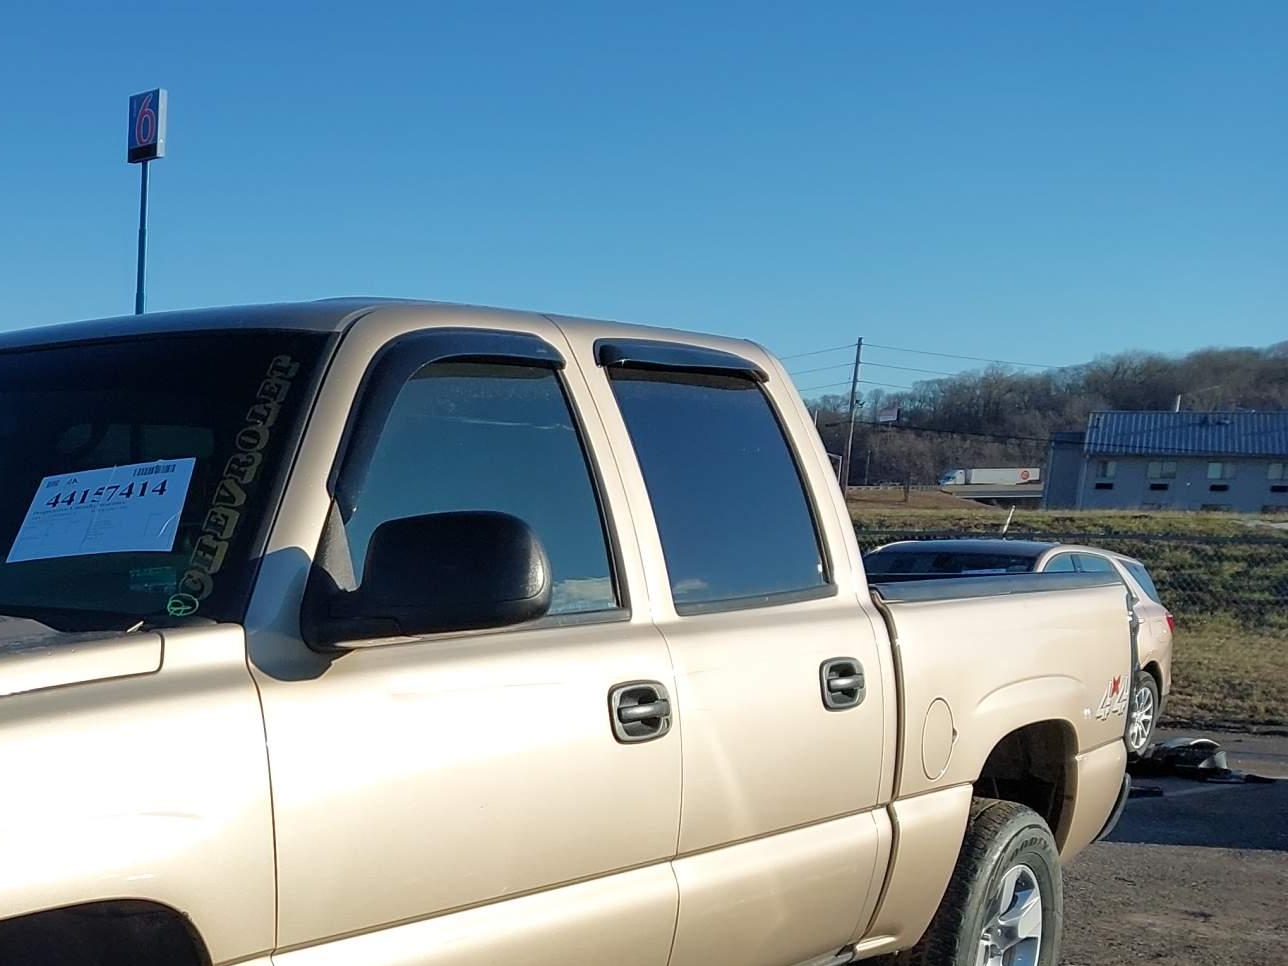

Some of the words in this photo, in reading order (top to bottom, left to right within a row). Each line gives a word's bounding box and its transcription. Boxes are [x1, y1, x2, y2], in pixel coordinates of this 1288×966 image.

[136, 92, 156, 145] 6
[46, 479, 168, 509] 44157414
[178, 354, 300, 601] CHEVROLET
